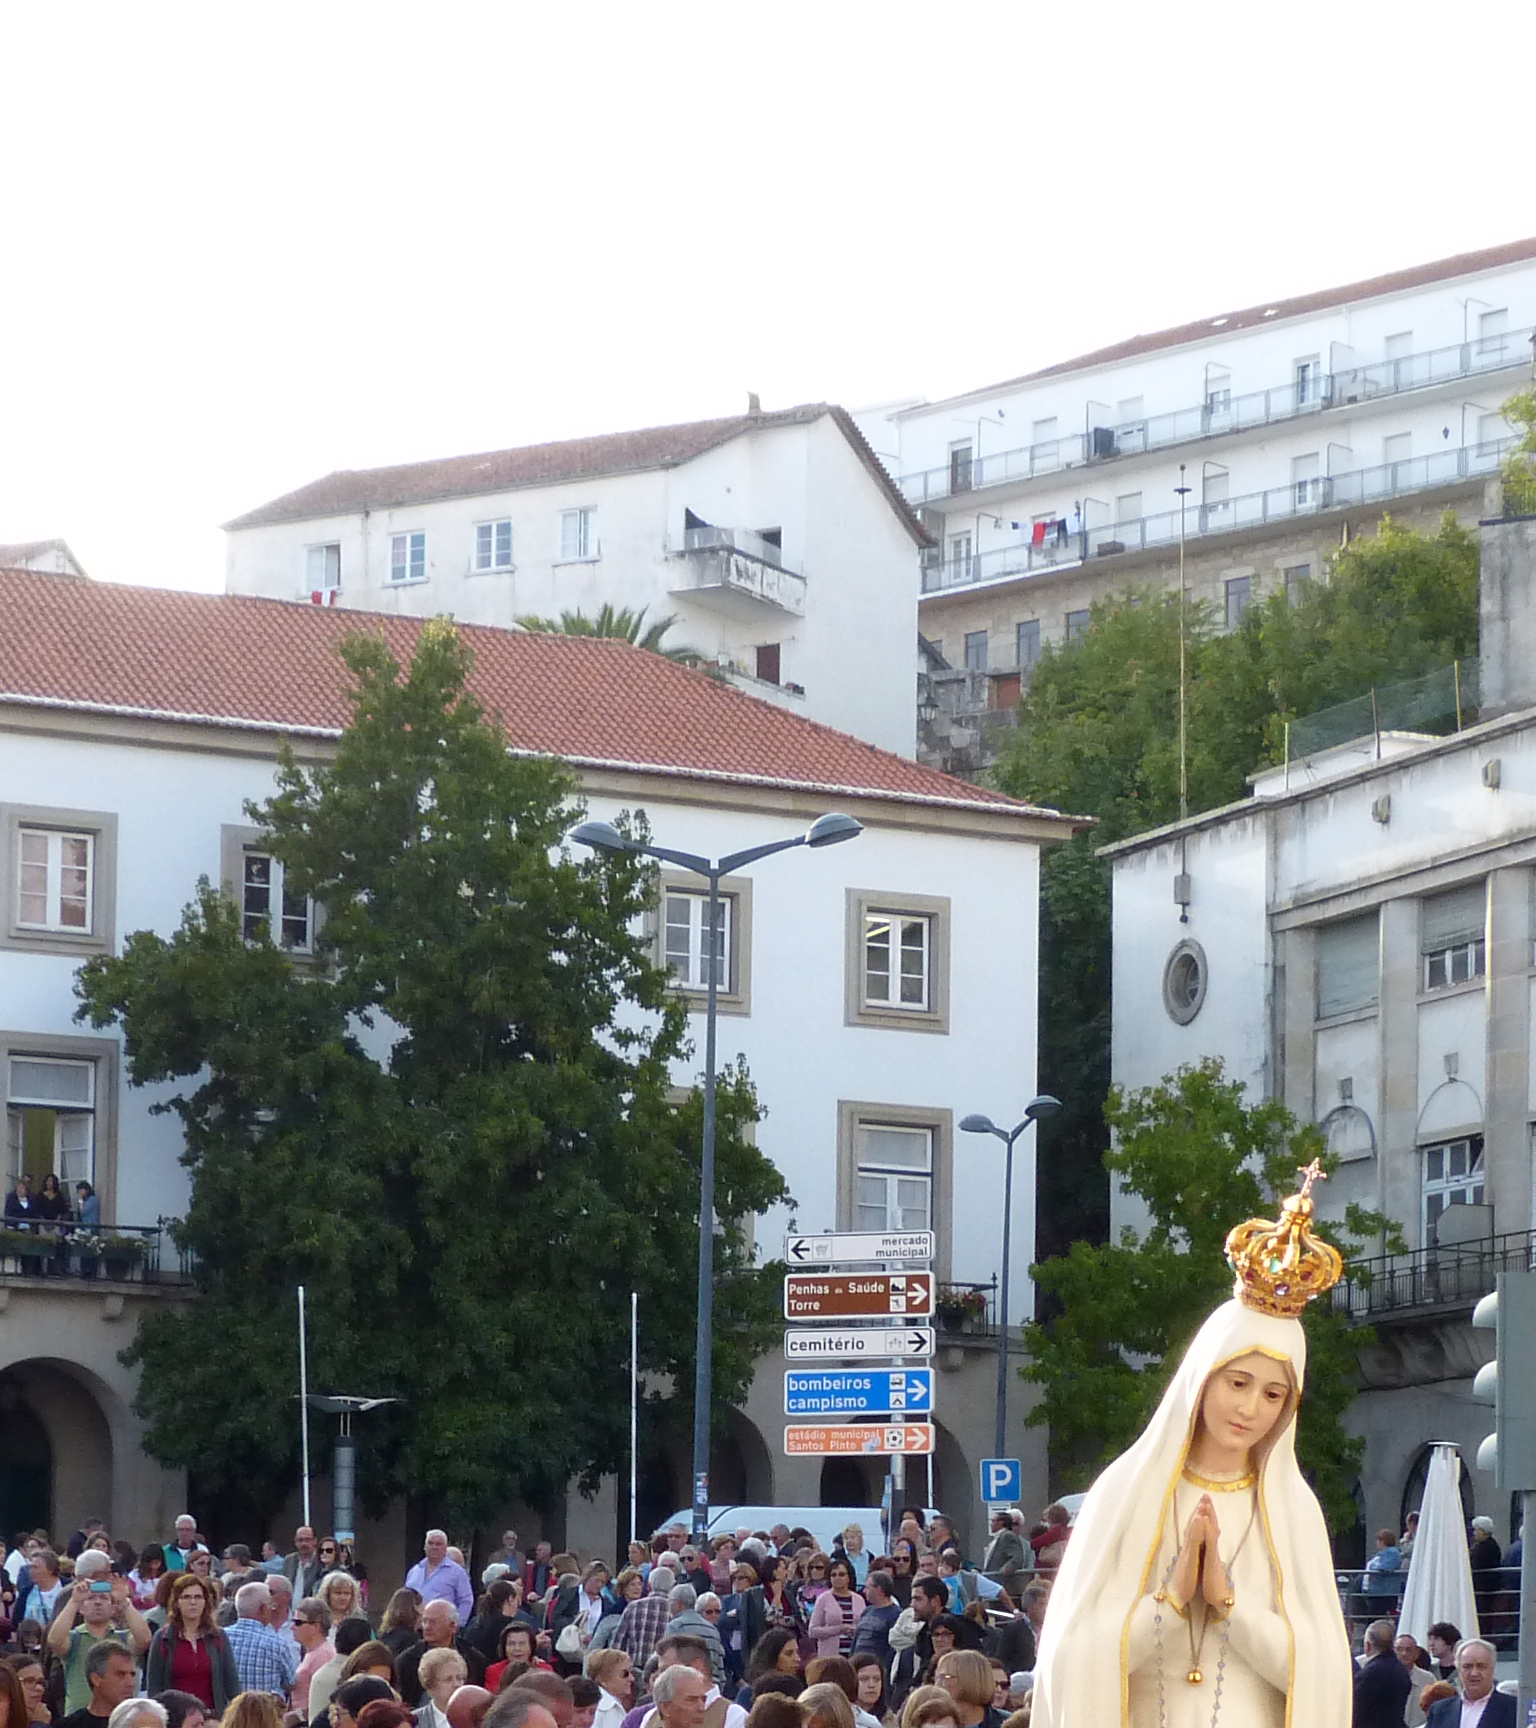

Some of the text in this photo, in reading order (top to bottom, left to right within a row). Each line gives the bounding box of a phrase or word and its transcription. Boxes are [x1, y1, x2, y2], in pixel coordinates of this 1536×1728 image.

[881, 1235, 928, 1246] mercado
[875, 1246, 927, 1258] municipal
[789, 1283, 830, 1295] Penhas
[848, 1281, 885, 1294] Saúde
[789, 1299, 821, 1311] Torre
[789, 1333, 865, 1352] cemitério
[788, 1377, 872, 1391] bombeiros
[788, 1396, 867, 1412] campismo
[788, 1428, 879, 1441] estádio municipal
[788, 1440, 857, 1451] Santos Pinto
[989, 1464, 1012, 1498] P
